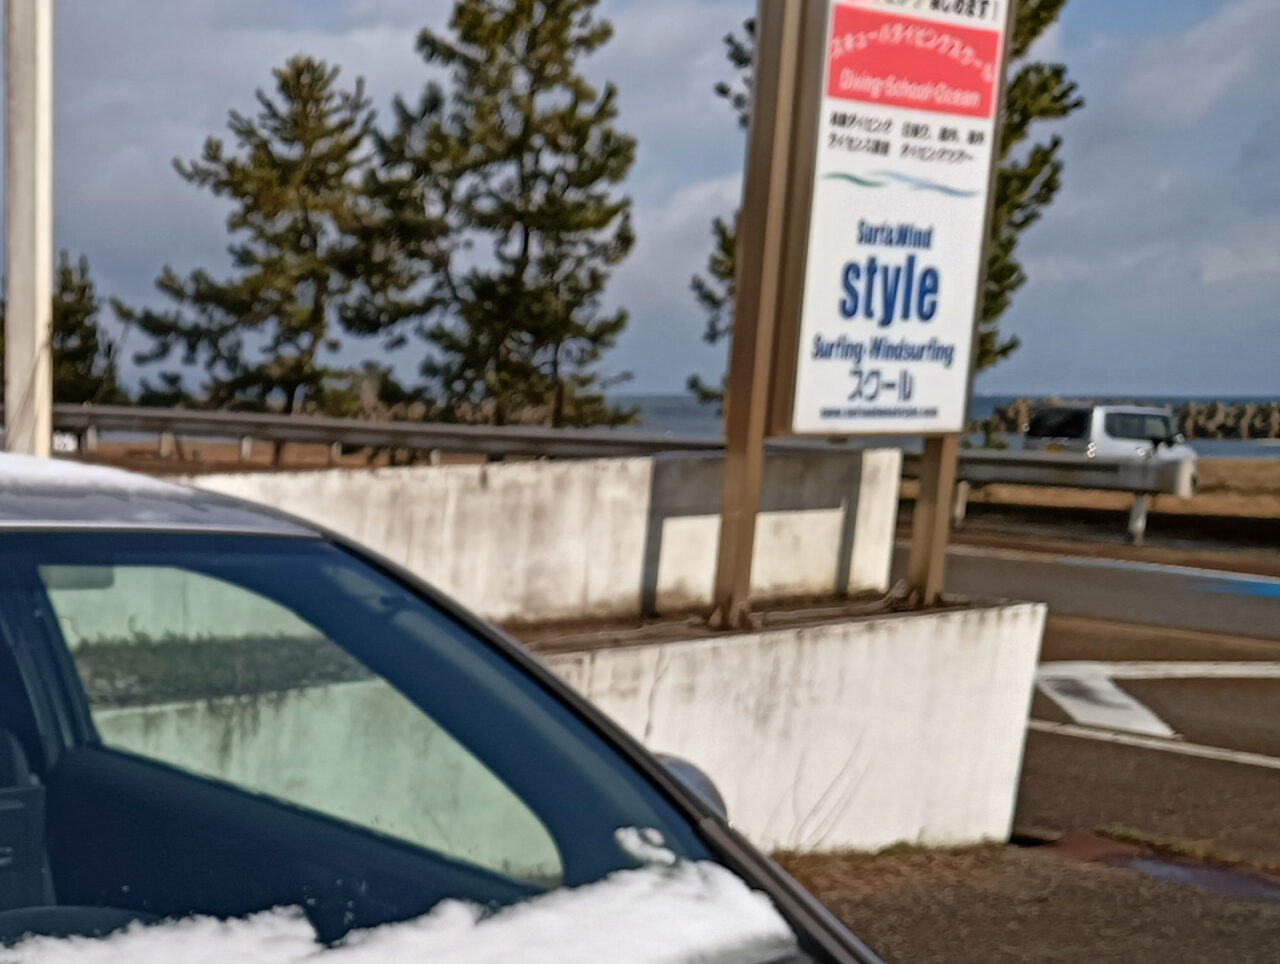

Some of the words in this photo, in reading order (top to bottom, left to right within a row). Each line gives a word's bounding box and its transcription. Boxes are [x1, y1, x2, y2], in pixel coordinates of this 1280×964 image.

[839, 255, 940, 327] style
[847, 368, 914, 402] スクール
